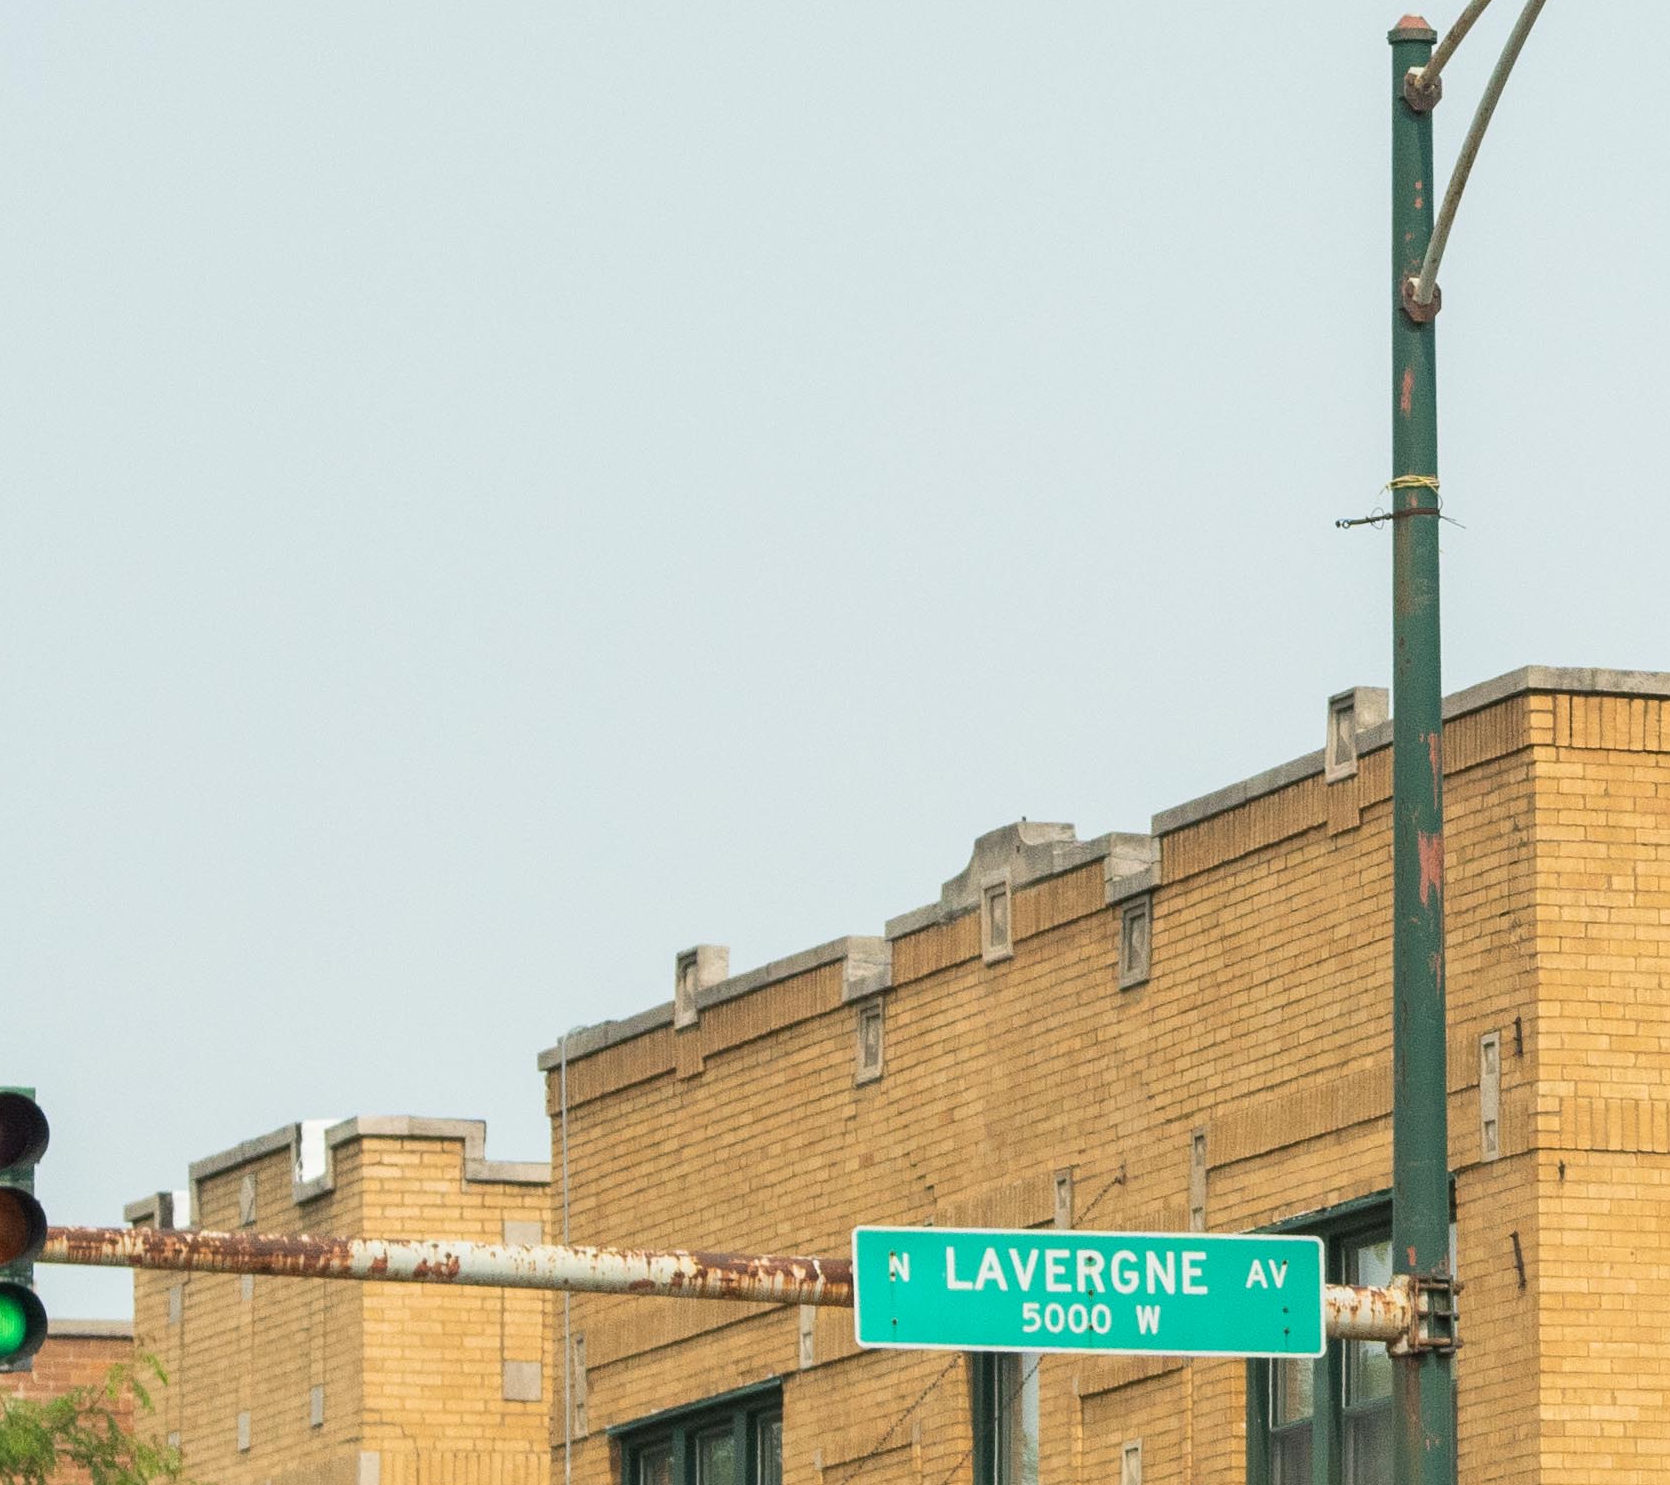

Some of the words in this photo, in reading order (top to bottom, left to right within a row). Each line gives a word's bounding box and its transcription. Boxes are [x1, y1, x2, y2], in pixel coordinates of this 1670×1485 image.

[889, 1253, 910, 1283] N
[945, 1247, 1209, 1296] LAVERGNE
[1245, 1259, 1289, 1289] AV
[1021, 1302, 1113, 1335] 5000
[1136, 1305, 1160, 1335] W
